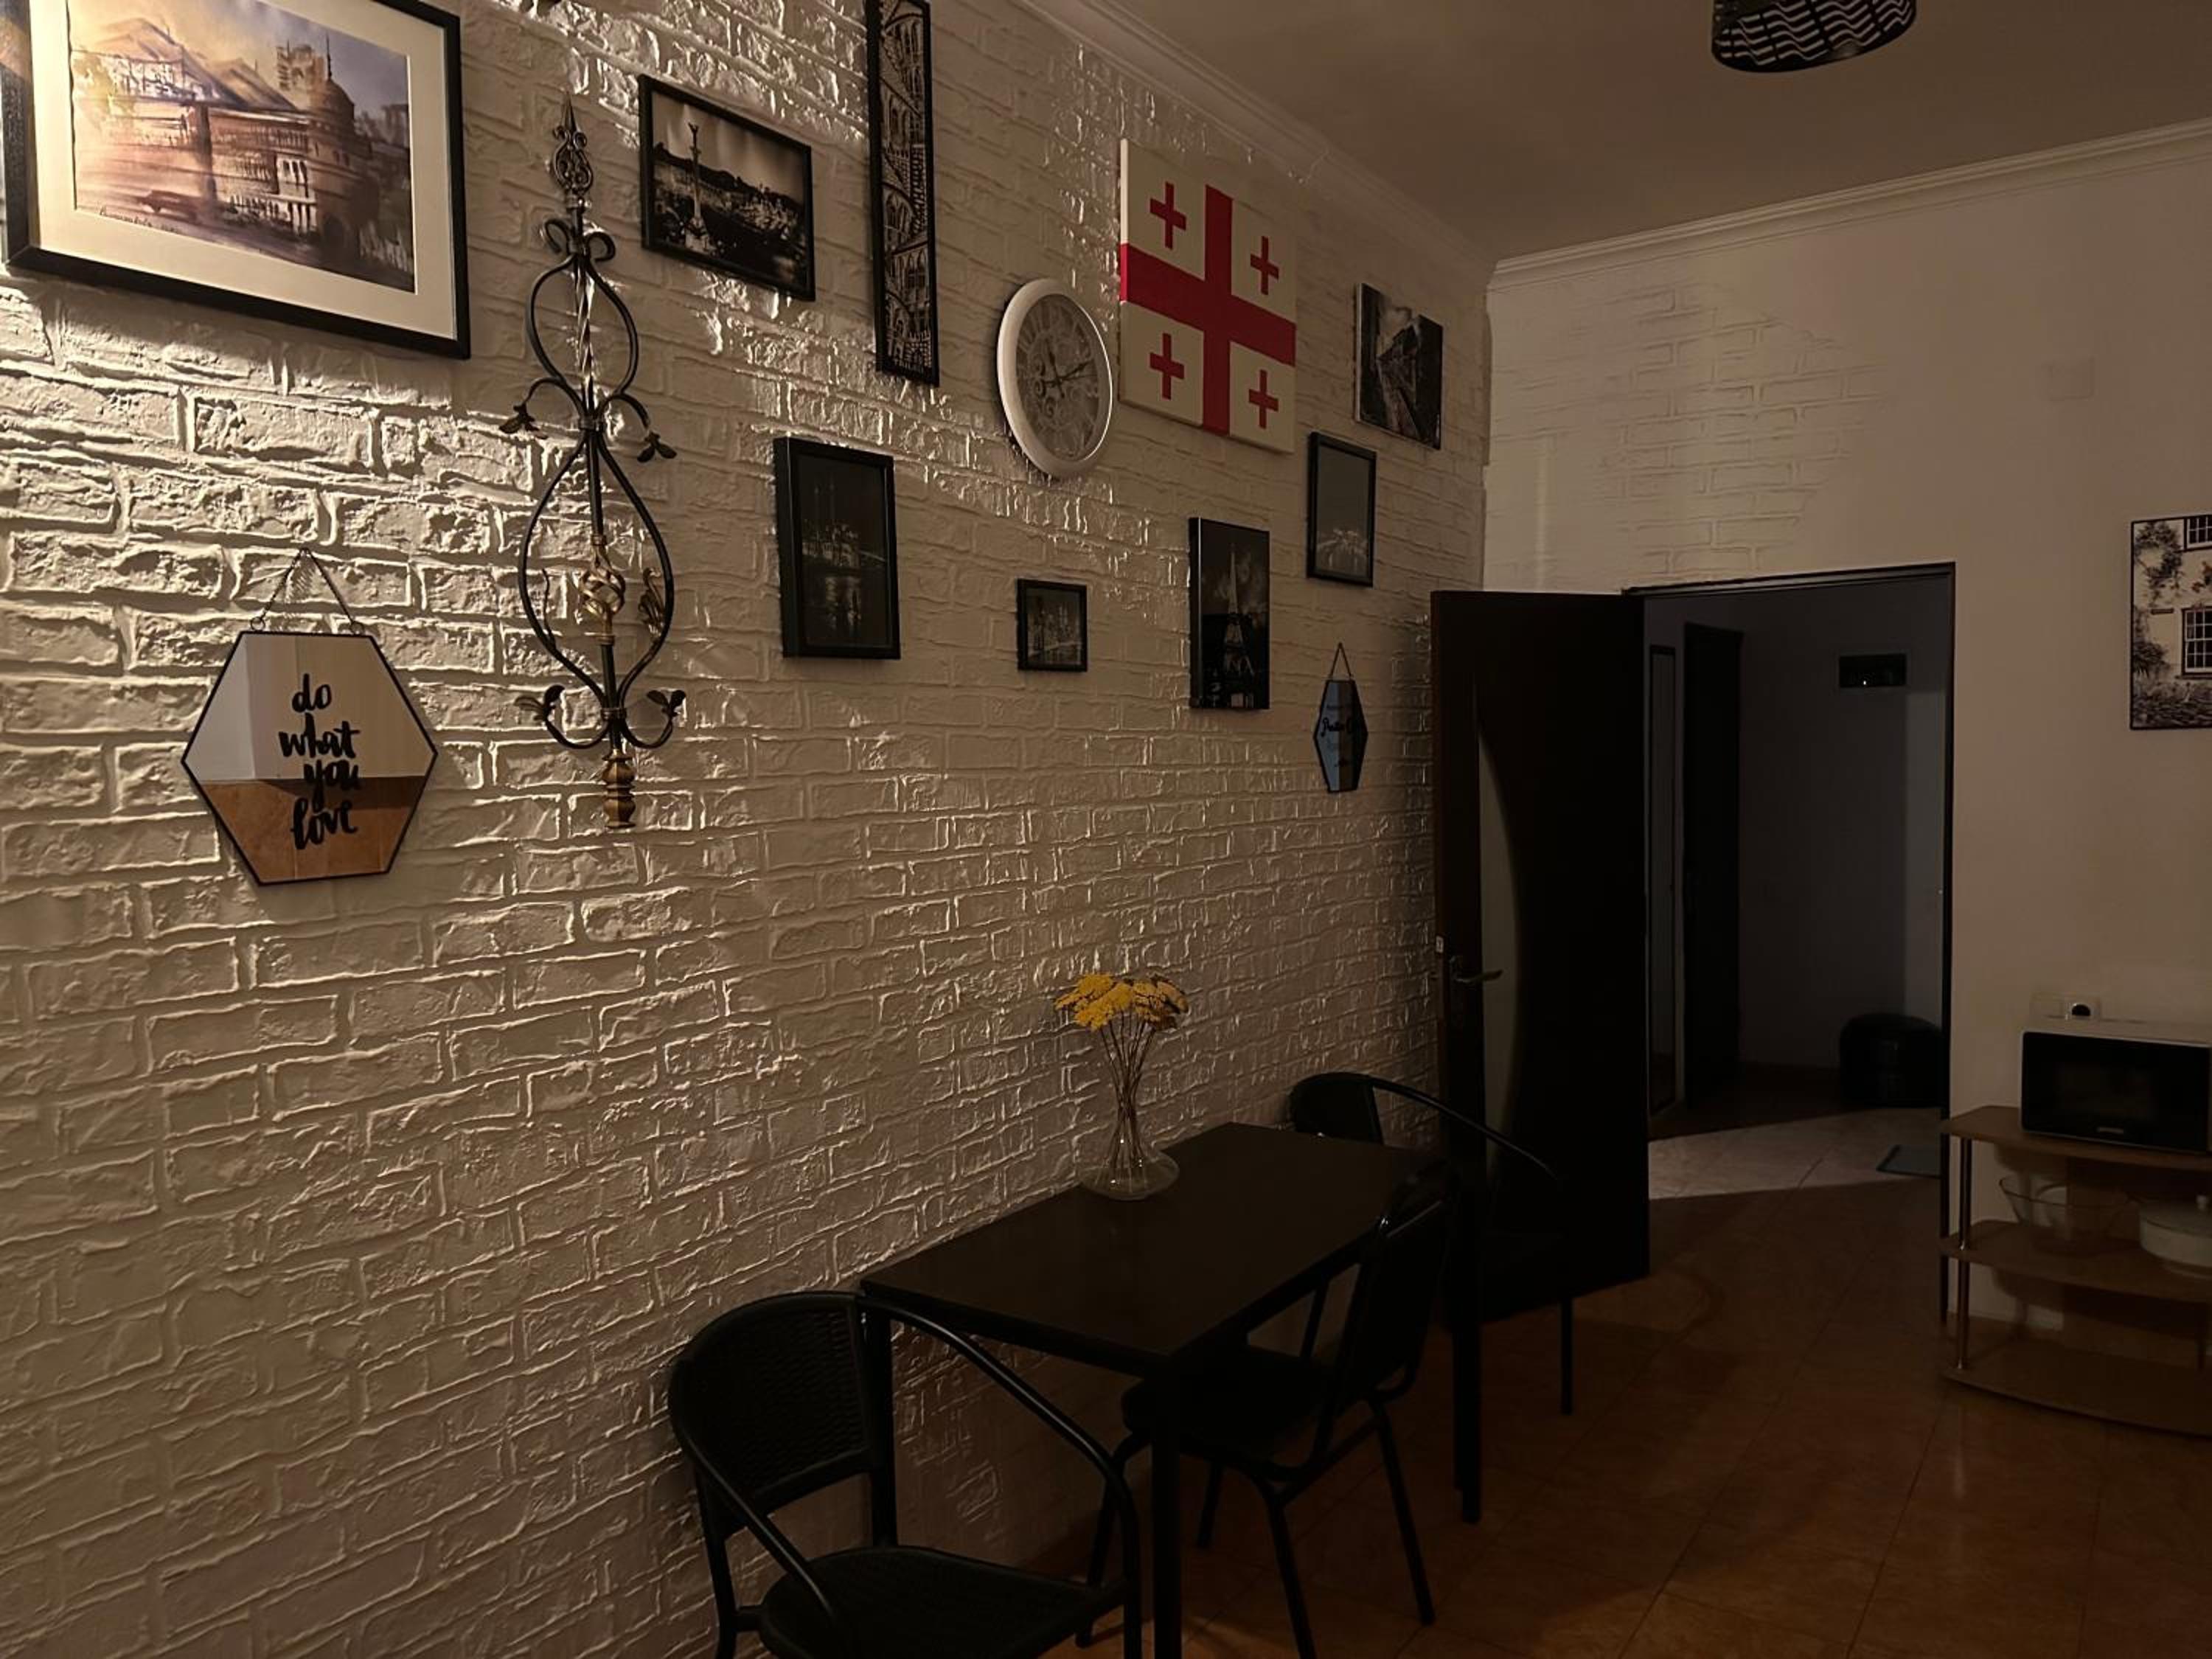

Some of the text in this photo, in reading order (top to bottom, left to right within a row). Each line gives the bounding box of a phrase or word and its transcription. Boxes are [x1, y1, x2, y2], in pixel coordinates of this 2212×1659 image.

[292, 673, 332, 712] do
[279, 712, 360, 758] what
[304, 759, 361, 813] you
[291, 797, 358, 849] love
